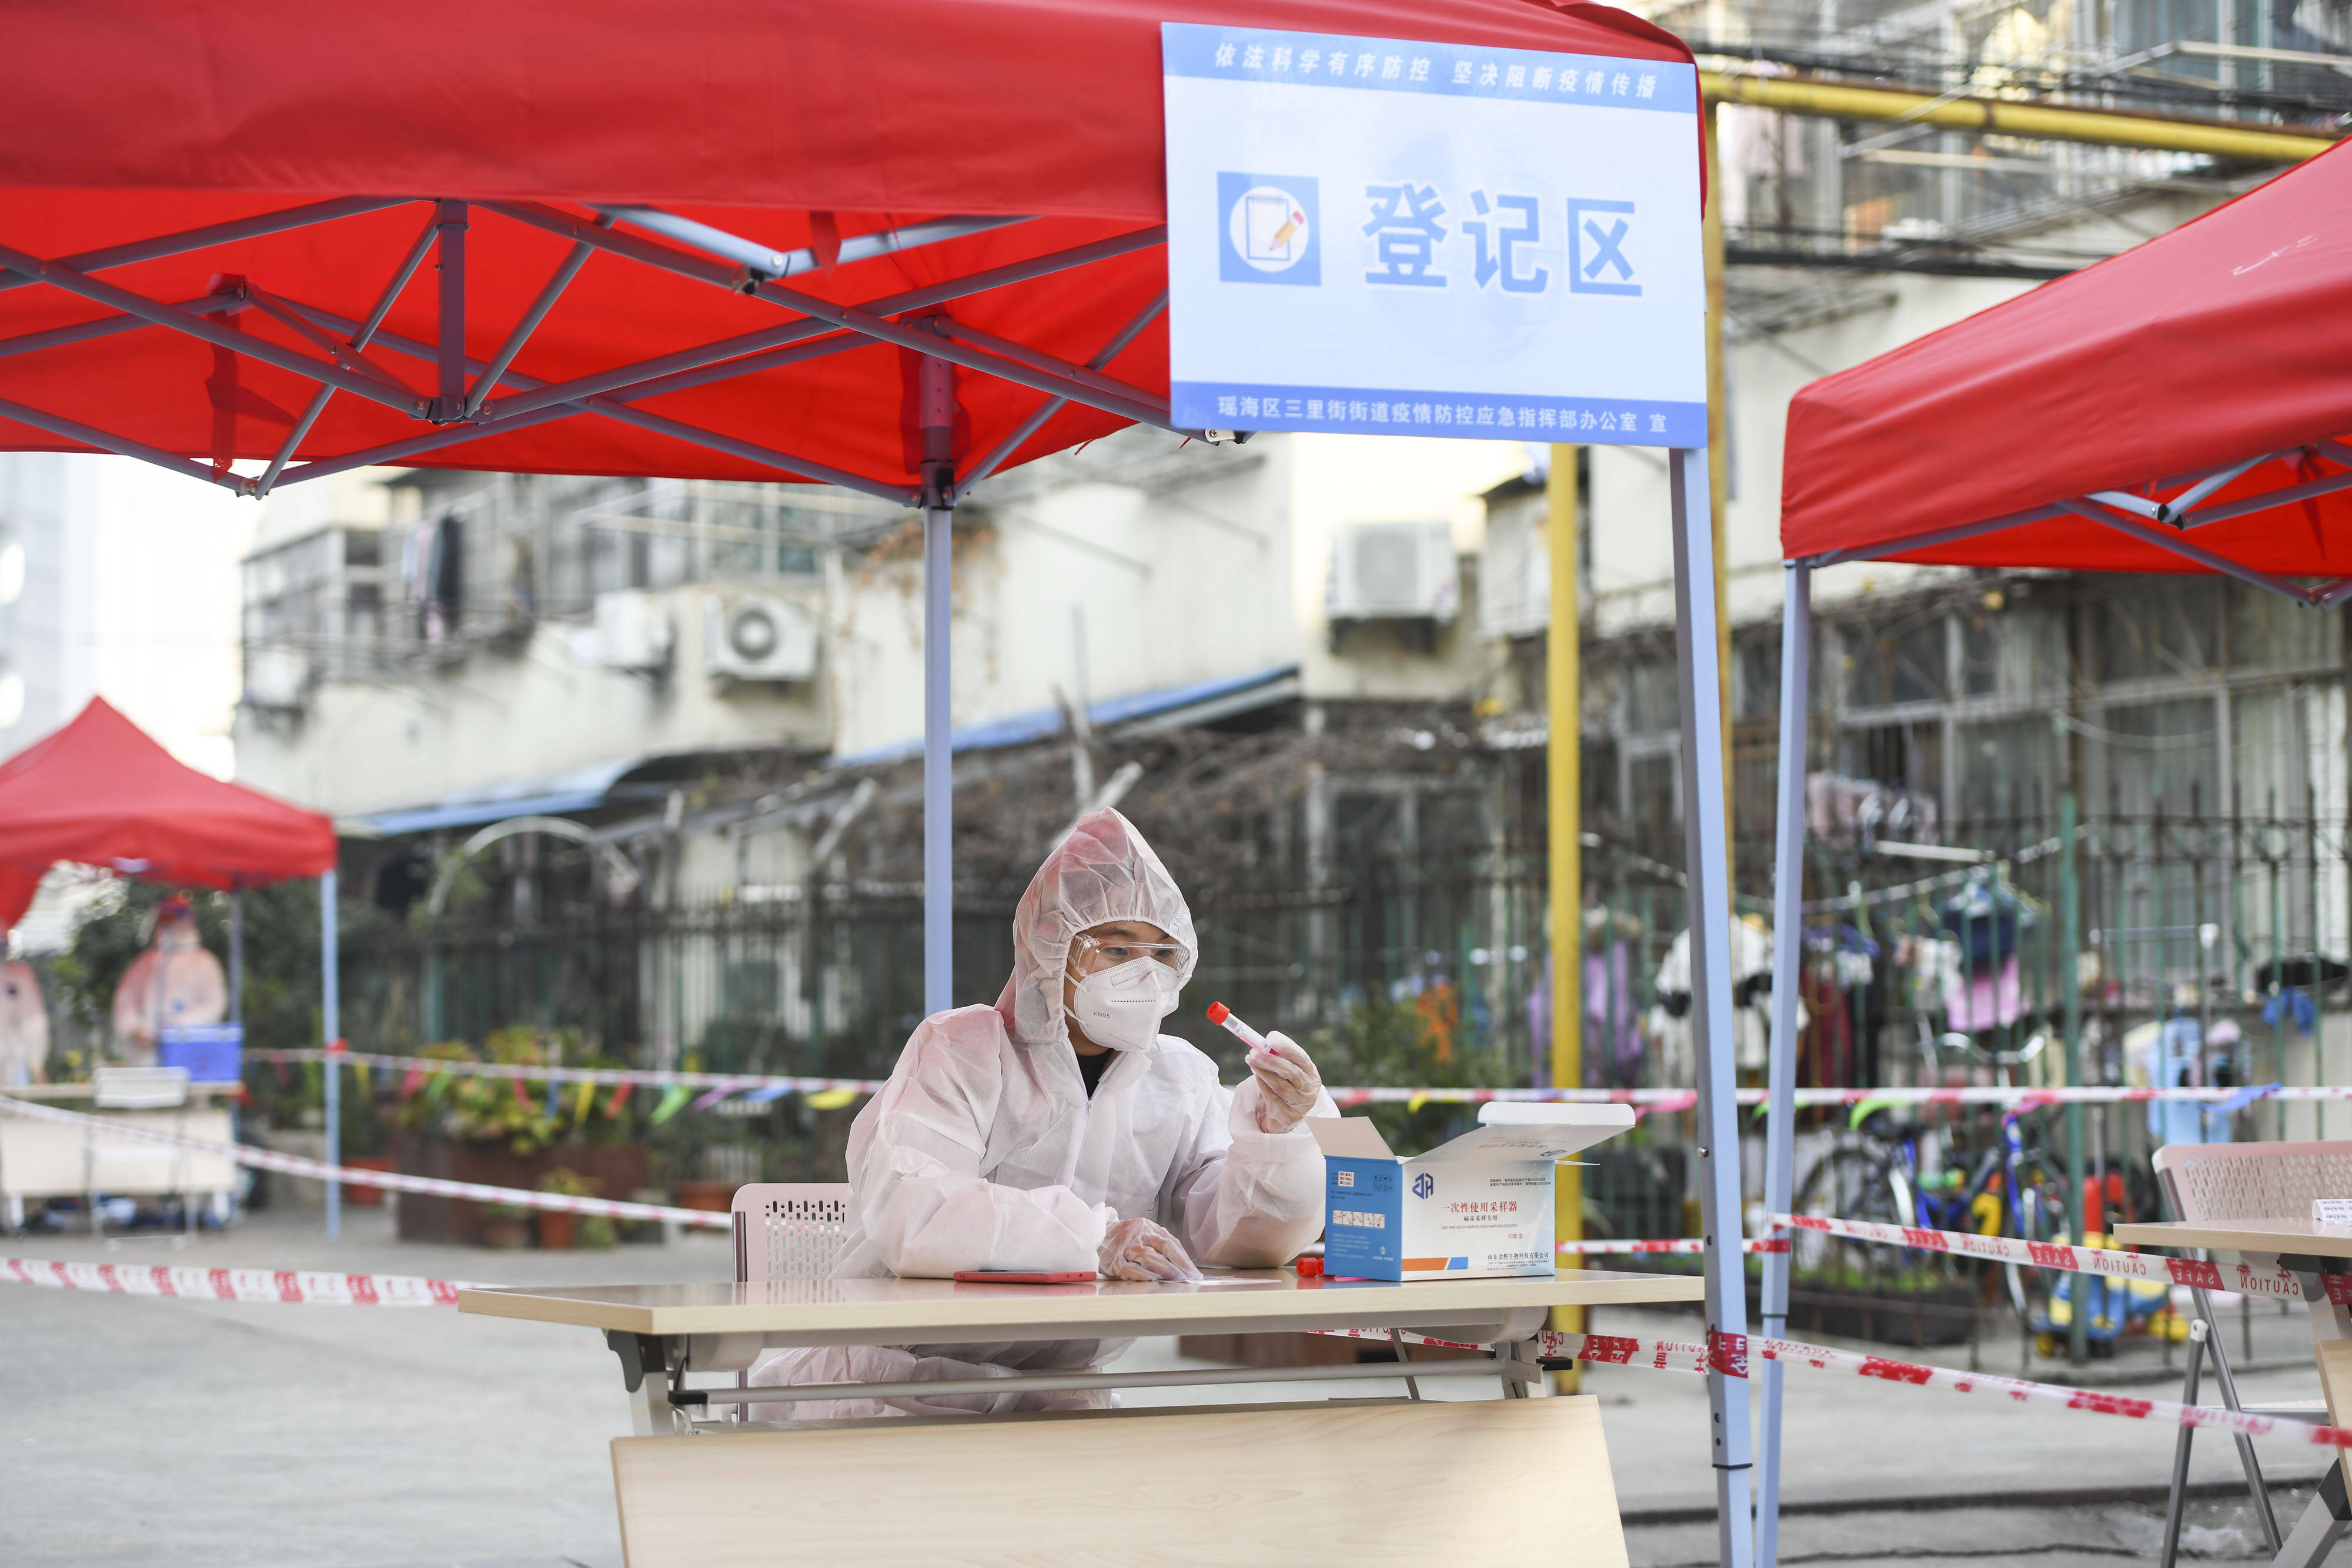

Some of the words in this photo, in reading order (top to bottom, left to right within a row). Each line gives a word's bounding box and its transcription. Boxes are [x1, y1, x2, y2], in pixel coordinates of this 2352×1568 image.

[1215, 42, 1431, 81] 依法科学有序防控
[1452, 60, 1656, 98] 坚决阻断疫情传播
[1361, 183, 1643, 296] 登记区
[1218, 396, 1636, 431] 瑶海区三里街街道疫情防控应急指挥部办公室
[1649, 413, 1667, 432] 宣
[1441, 1201, 1517, 1213] 一次性使用采样器
